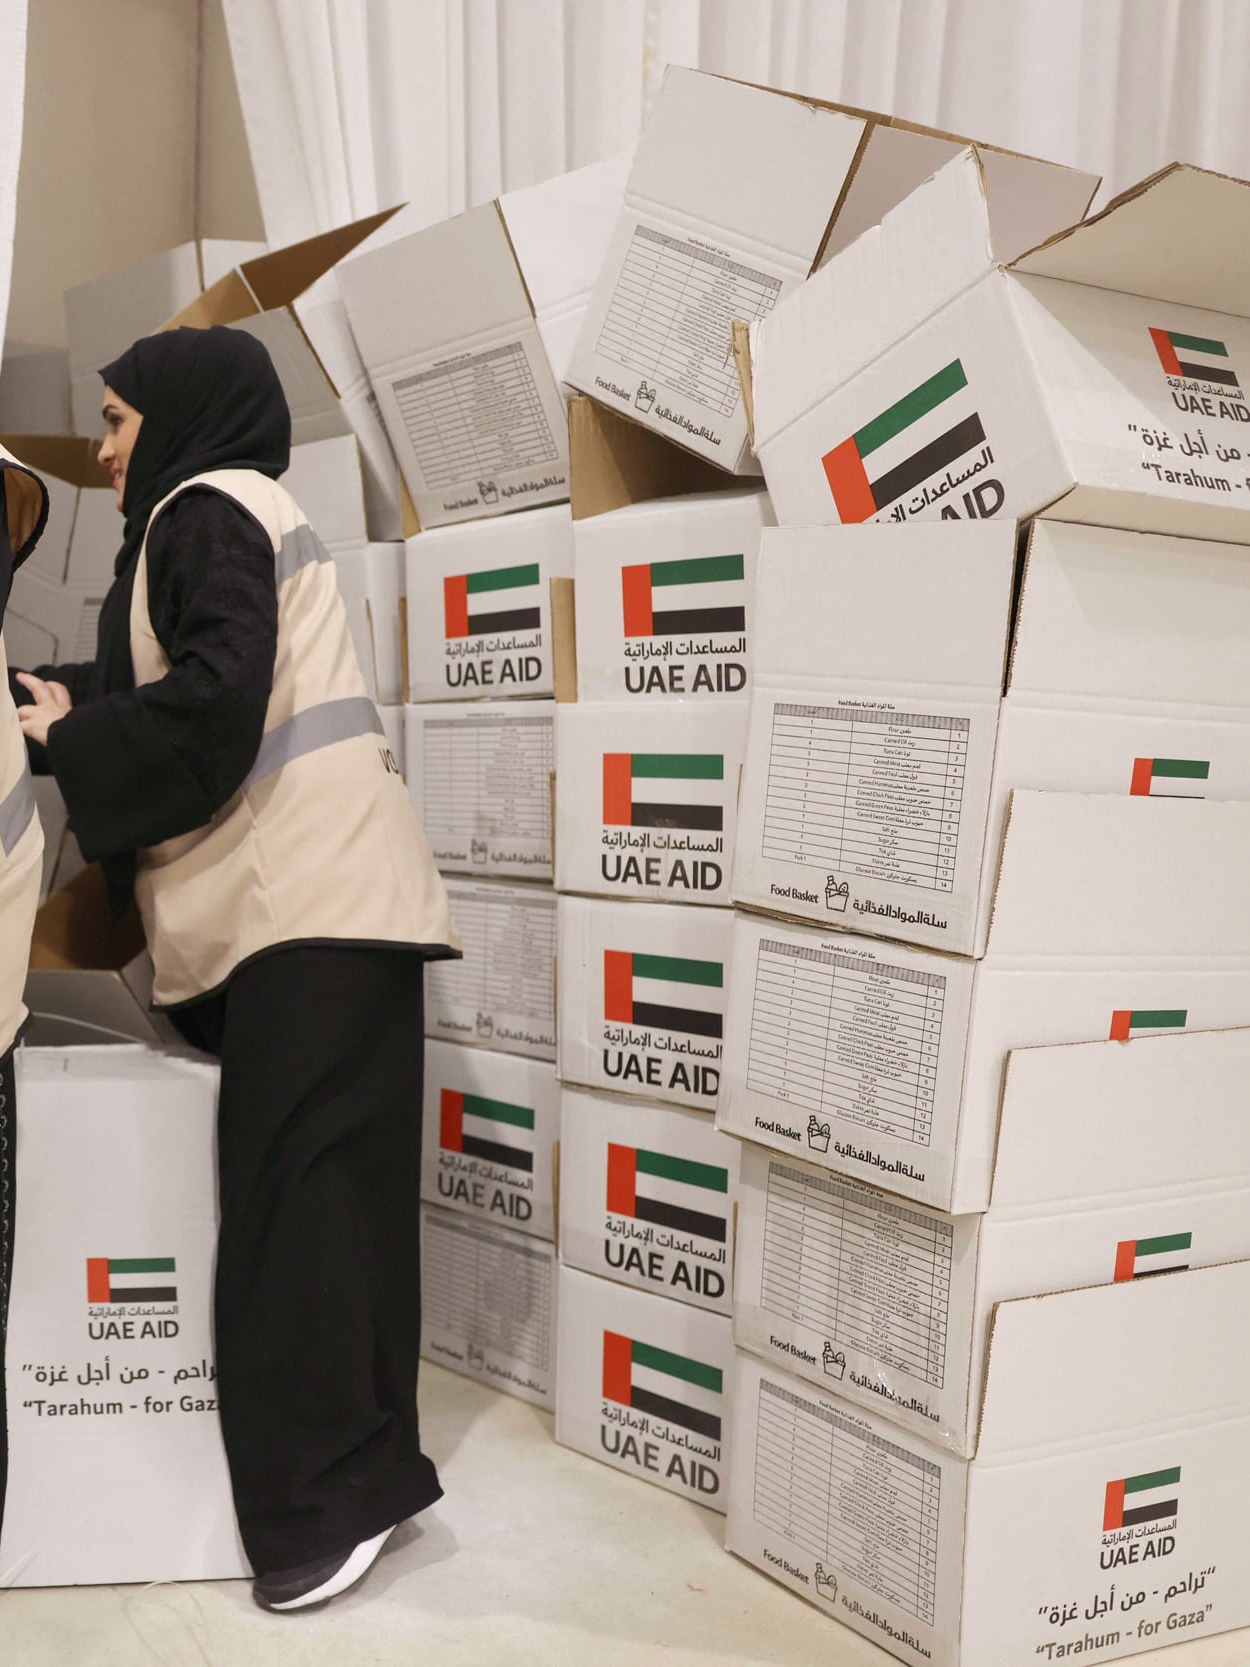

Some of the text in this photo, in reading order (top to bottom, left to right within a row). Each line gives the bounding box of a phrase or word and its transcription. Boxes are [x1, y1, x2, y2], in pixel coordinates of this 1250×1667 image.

[1172, 392, 1250, 422] UAE AID
[1203, 384, 1245, 400] المساعدات
[675, 637, 746, 655] المساعدات
[445, 656, 542, 687] UAE AID
[624, 662, 747, 694] UAE AID
[653, 833, 723, 853] المساعدات
[601, 854, 723, 891] UAE AID
[770, 884, 819, 904] Food Basket
[654, 1037, 723, 1060] المساعدات
[603, 1049, 721, 1096] UAE AID
[755, 1117, 802, 1141] Food Basket
[437, 1172, 532, 1222] UAE AID
[656, 1234, 726, 1264] المساعدات
[604, 1238, 726, 1299] UAE AID
[88, 1320, 180, 1340] UAE AID
[770, 1336, 817, 1365] Food Basket
[77, 1356, 110, 1386] أجل
[120, 1367, 149, 1384] من
[144, 1396, 173, 1413] for
[180, 1395, 220, 1412] Gaz
[651, 1427, 721, 1462] المساعدات
[600, 1424, 719, 1496] UAE AID
[1134, 1519, 1177, 1539] المساعدات
[763, 1549, 809, 1584] Food Basket
[1100, 1536, 1175, 1570] UAE AID
[1085, 1584, 1115, 1618] أجل
[1120, 1590, 1146, 1612] من
[1137, 1620, 1161, 1638] for
